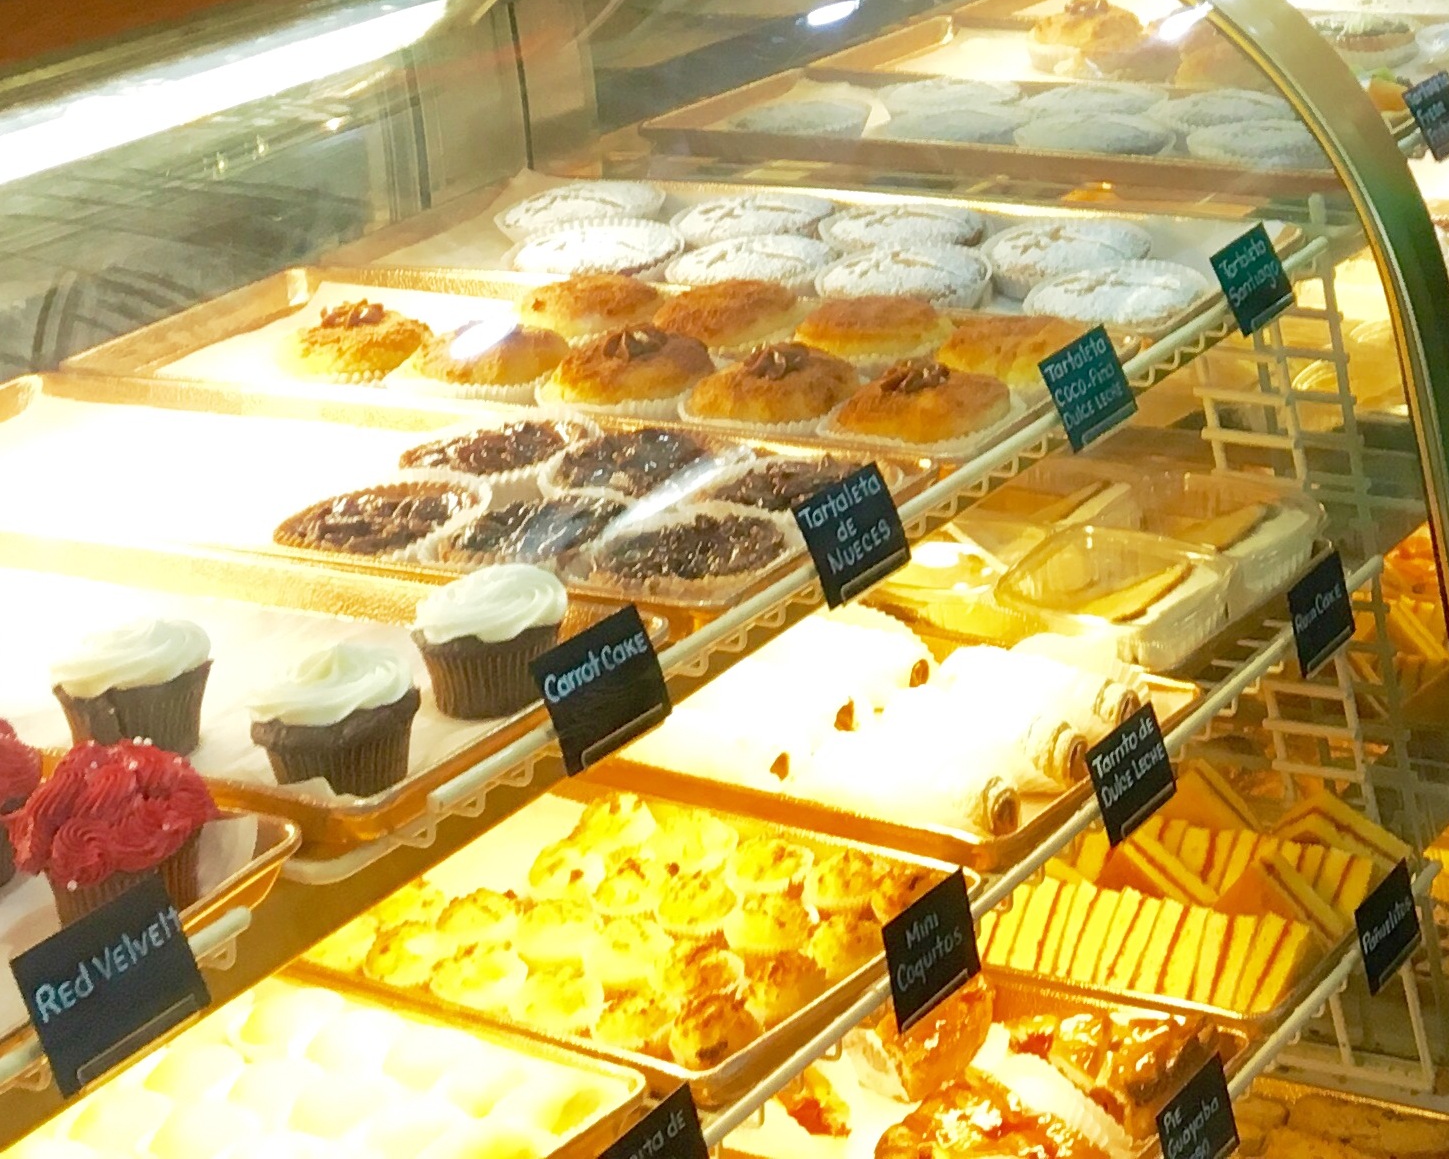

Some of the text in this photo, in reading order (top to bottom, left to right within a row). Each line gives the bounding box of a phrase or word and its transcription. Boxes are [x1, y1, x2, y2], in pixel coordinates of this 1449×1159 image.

[543, 650, 601, 703] Carrot
[904, 911, 940, 949] Mini
[896, 925, 963, 992] Coquitos
